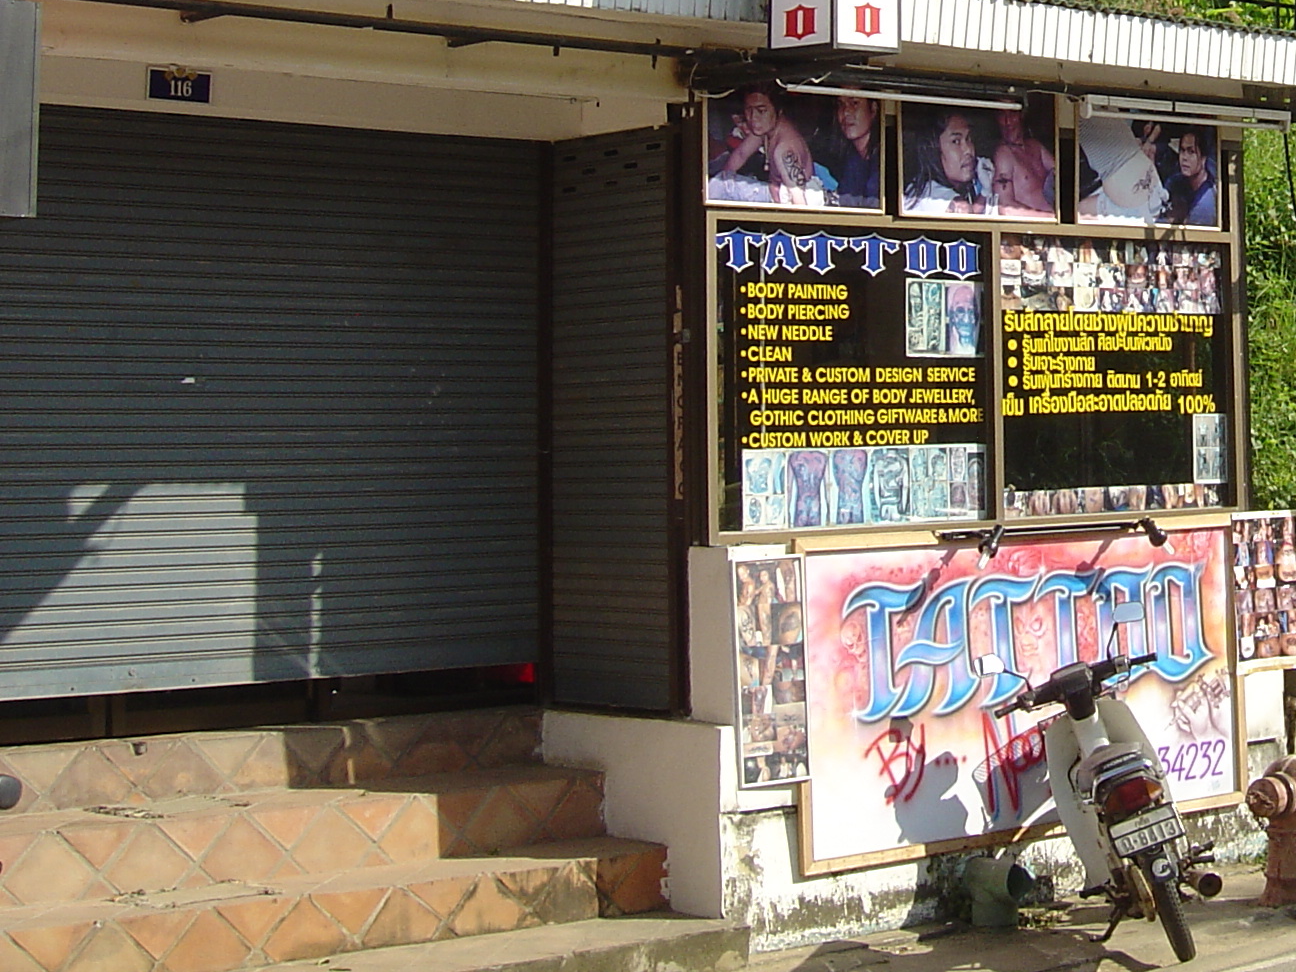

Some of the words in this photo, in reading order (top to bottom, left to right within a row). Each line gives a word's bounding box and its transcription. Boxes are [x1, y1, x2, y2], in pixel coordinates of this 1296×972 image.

[170, 80, 192, 97] 116
[716, 226, 982, 281] TATTOO
[747, 284, 785, 299] BODY
[787, 285, 848, 300] PAINTING
[747, 304, 785, 319] BODY
[787, 304, 850, 319] PIERCING
[747, 325, 778, 341] NEW
[782, 325, 833, 341] NEDDLE
[747, 346, 792, 362] CLEAN
[748, 367, 799, 383] PRIVATE
[801, 368, 813, 383] &
[815, 367, 870, 383] CUSTOM
[875, 367, 923, 383] DESIGN
[927, 366, 976, 382] SERVICE
[1145, 371, 1166, 388] 1-2
[747, 389, 759, 404] A
[761, 388, 799, 404] HUGE
[802, 388, 848, 404] RANGE
[851, 388, 870, 404] OF
[872, 388, 907, 404] BODY
[909, 388, 976, 406] JEWELLERY,
[1177, 393, 1216, 415] 100%
[749, 409, 805, 426] GOTHIC
[807, 409, 875, 426] CLOTHING
[749, 432, 806, 448] CUSTOM
[809, 431, 850, 447] WORK
[853, 431, 863, 446] &
[865, 430, 910, 446] COVER
[913, 429, 929, 445] UP
[843, 561, 1214, 724] TATTOO
